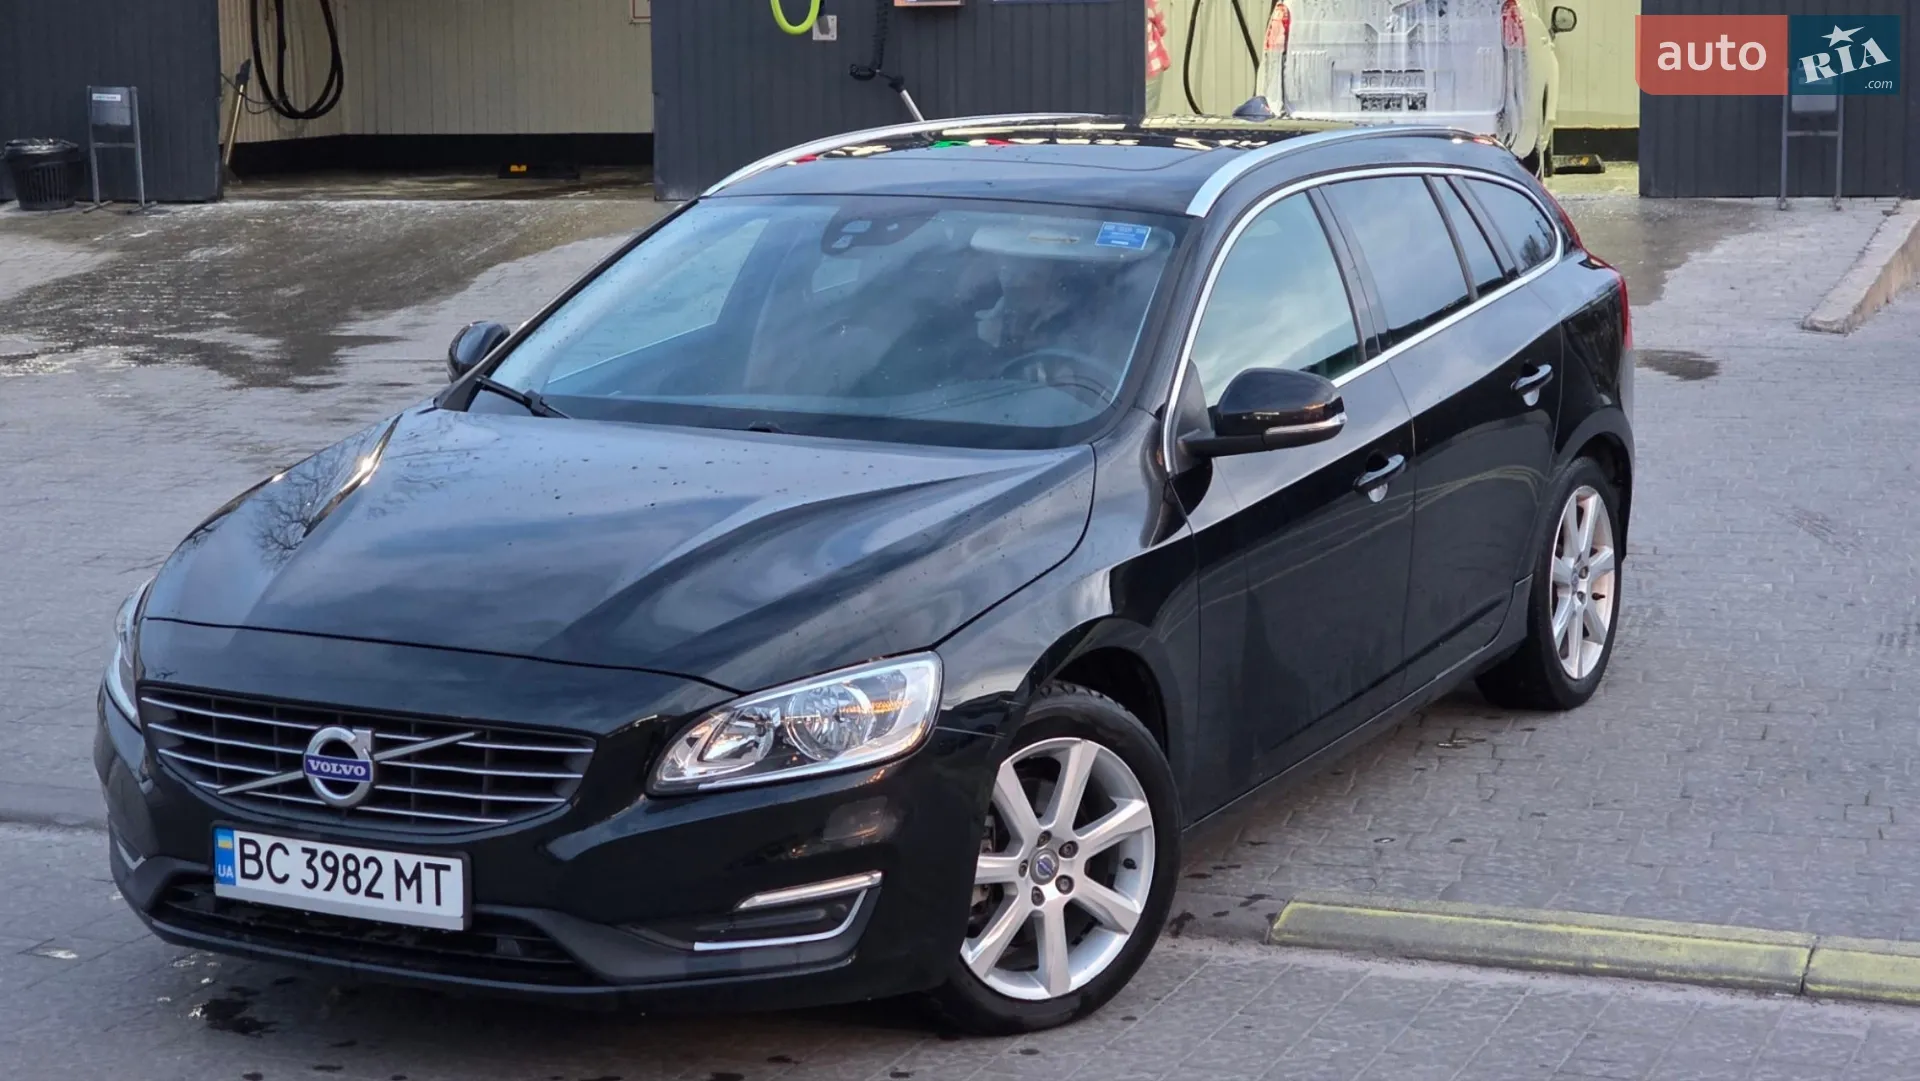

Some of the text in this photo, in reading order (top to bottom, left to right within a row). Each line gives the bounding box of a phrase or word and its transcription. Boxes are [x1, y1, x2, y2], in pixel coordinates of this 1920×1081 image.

[307, 758, 366, 776] VOLVO
[218, 864, 234, 879] UA
[238, 837, 451, 906] BC 3982 MT
